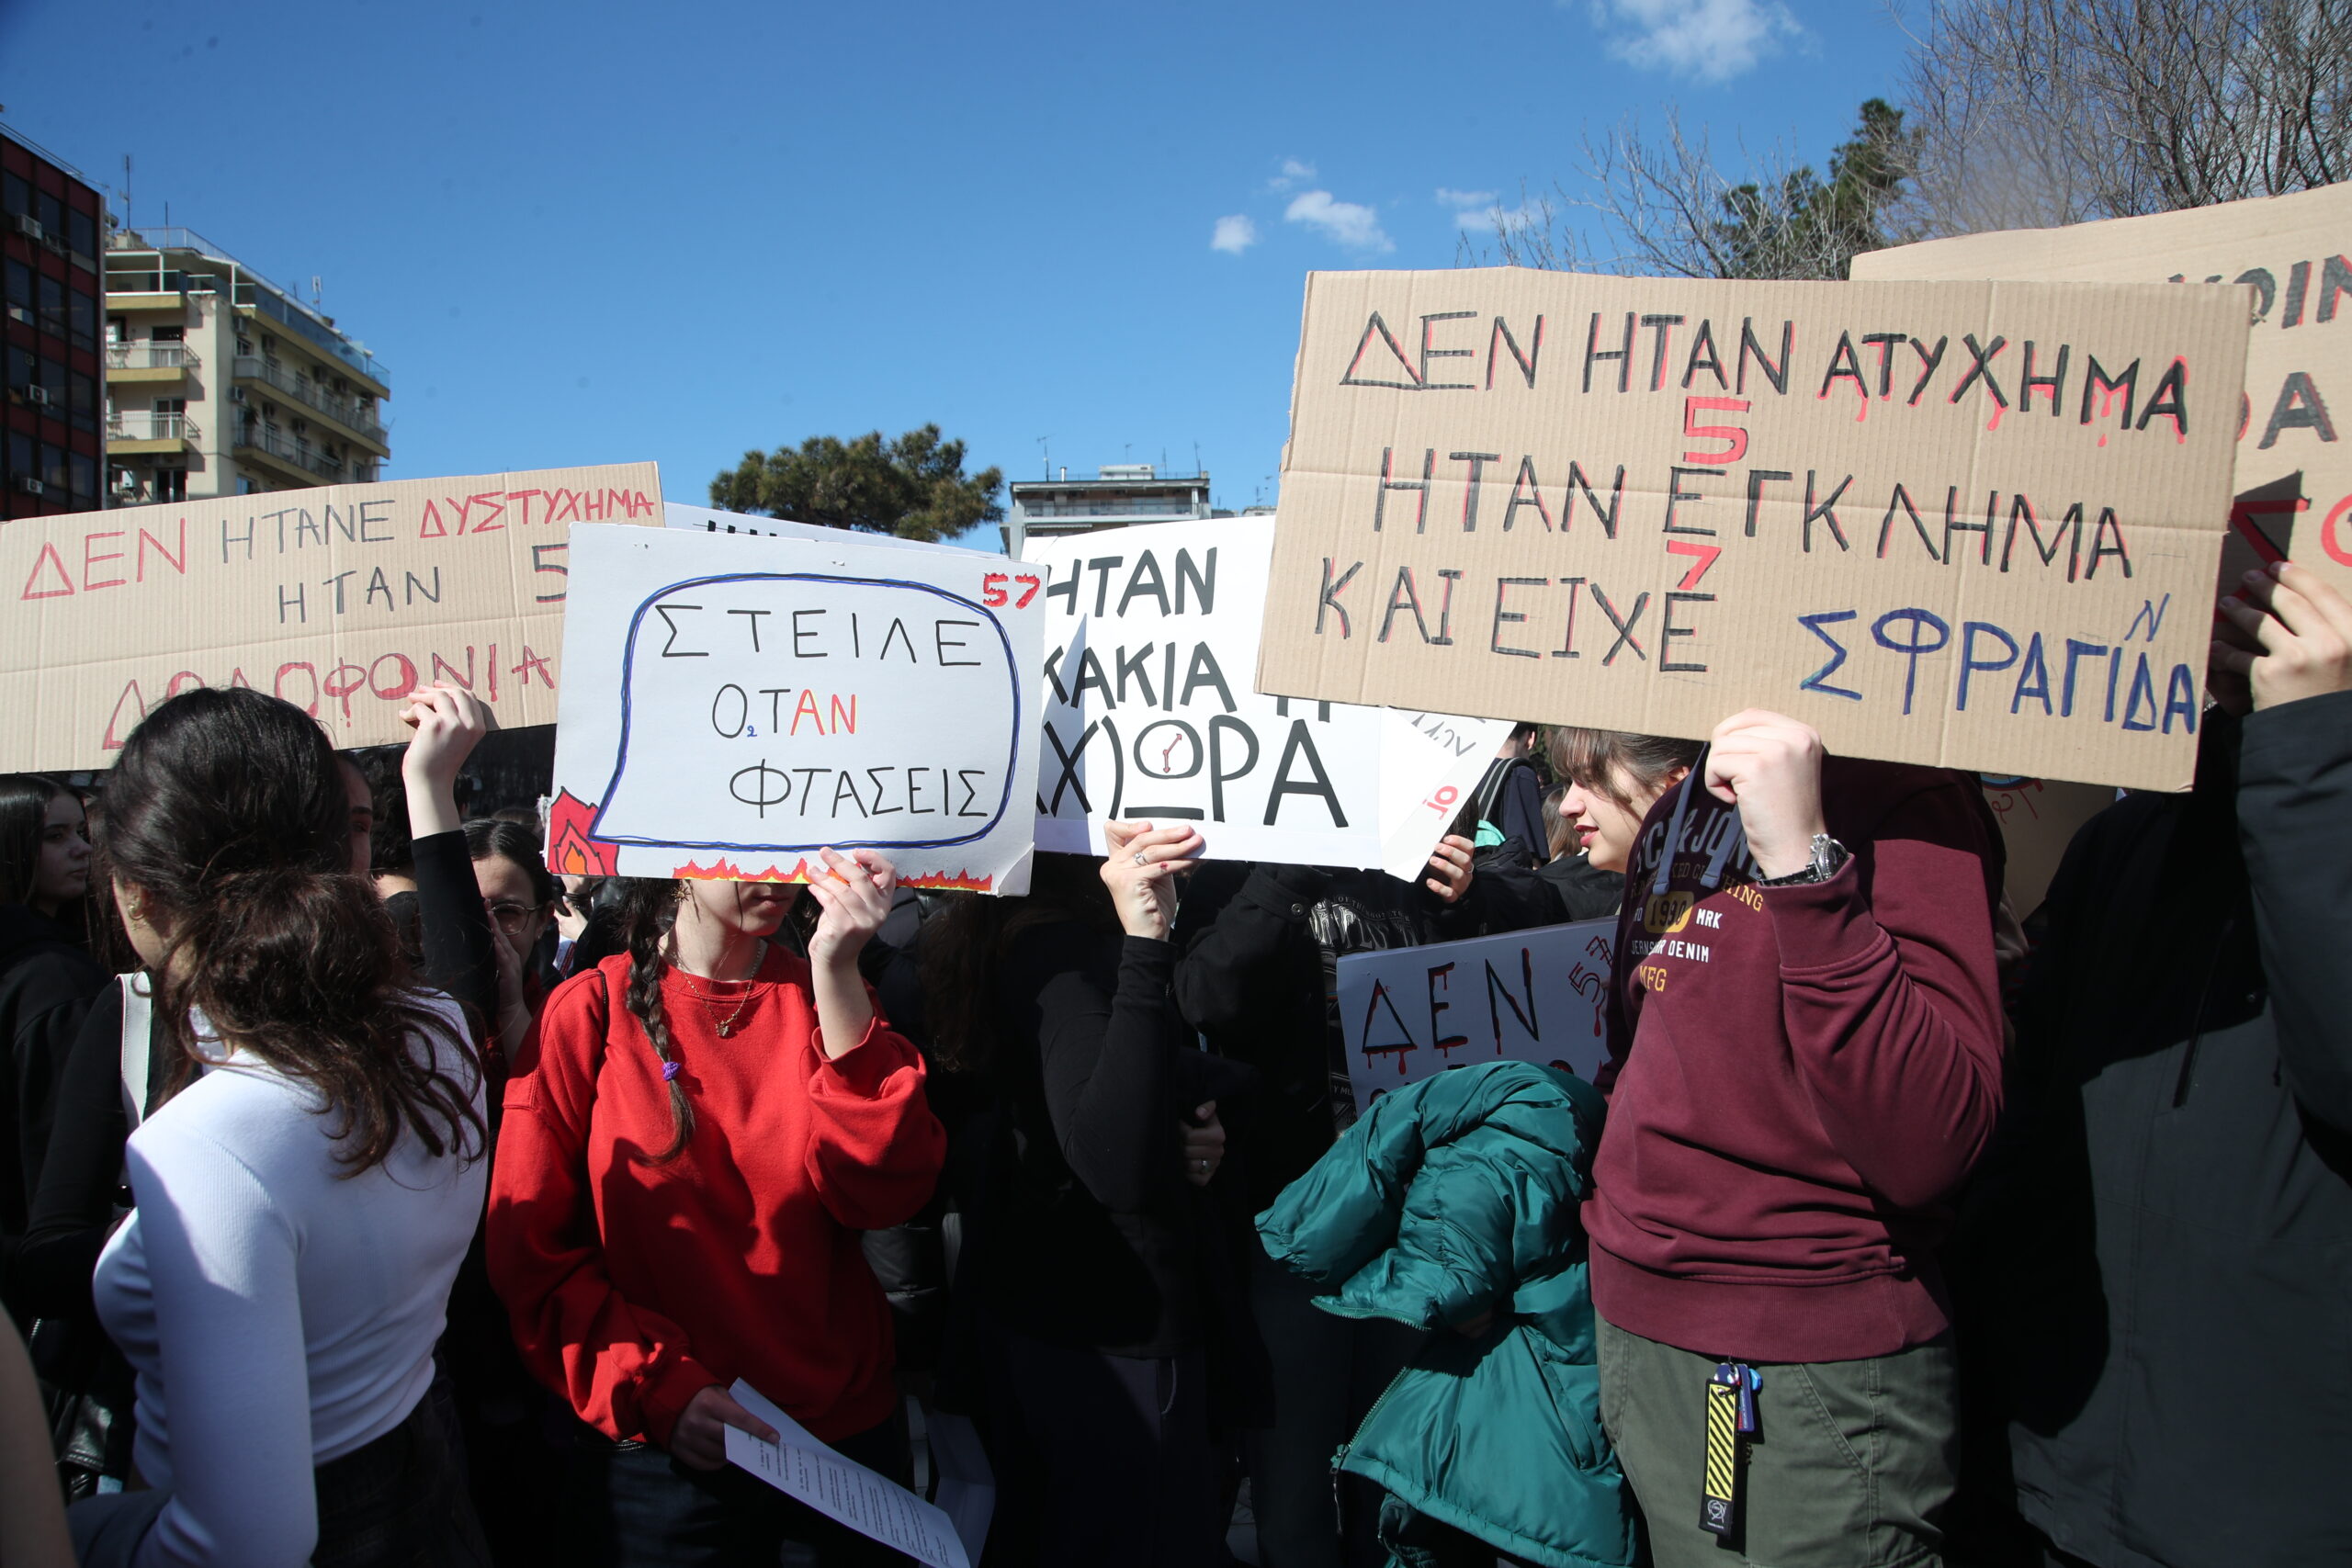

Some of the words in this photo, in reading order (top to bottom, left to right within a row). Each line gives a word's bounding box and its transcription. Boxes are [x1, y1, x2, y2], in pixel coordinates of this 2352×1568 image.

[1339, 310, 1545, 391] ΔΕΝ
[1581, 310, 1796, 395] ΗΤΑΝ
[1817, 329, 2189, 445] ΑΤΥΧΗΜΑ
[1683, 395, 1753, 466] 5
[20, 517, 187, 601] ΔΕΝ
[221, 500, 395, 564] ΗΤΑΝΕ
[419, 488, 655, 539] ΔΥΣΤΥΧΗΜΑ
[1374, 446, 1627, 540] ΗΤΑΝ
[1662, 466, 2132, 583] ΕΓΚΛΗΜΑ
[279, 566, 441, 624] ΗΤΑΝ
[982, 572, 1042, 610] 57
[1046, 547, 1217, 618] ΗΤΑΝ
[1666, 539, 1723, 591] 7
[655, 604, 982, 667] ΣΤΕΙΛΕ
[1314, 557, 1464, 647] ΚΑΙ
[1490, 576, 1719, 673] ΕΙΧΕ
[1797, 606, 2197, 735] ΣΦΡΑΓΙΔΑ
[729, 758, 989, 819] ΦΤΑΣΕΙΣ
[1695, 908, 1723, 930] MRK
[1638, 964, 1668, 992] MFG
[1668, 940, 1710, 964] DENIM
[1362, 947, 1540, 1066] ΔΕΝ
